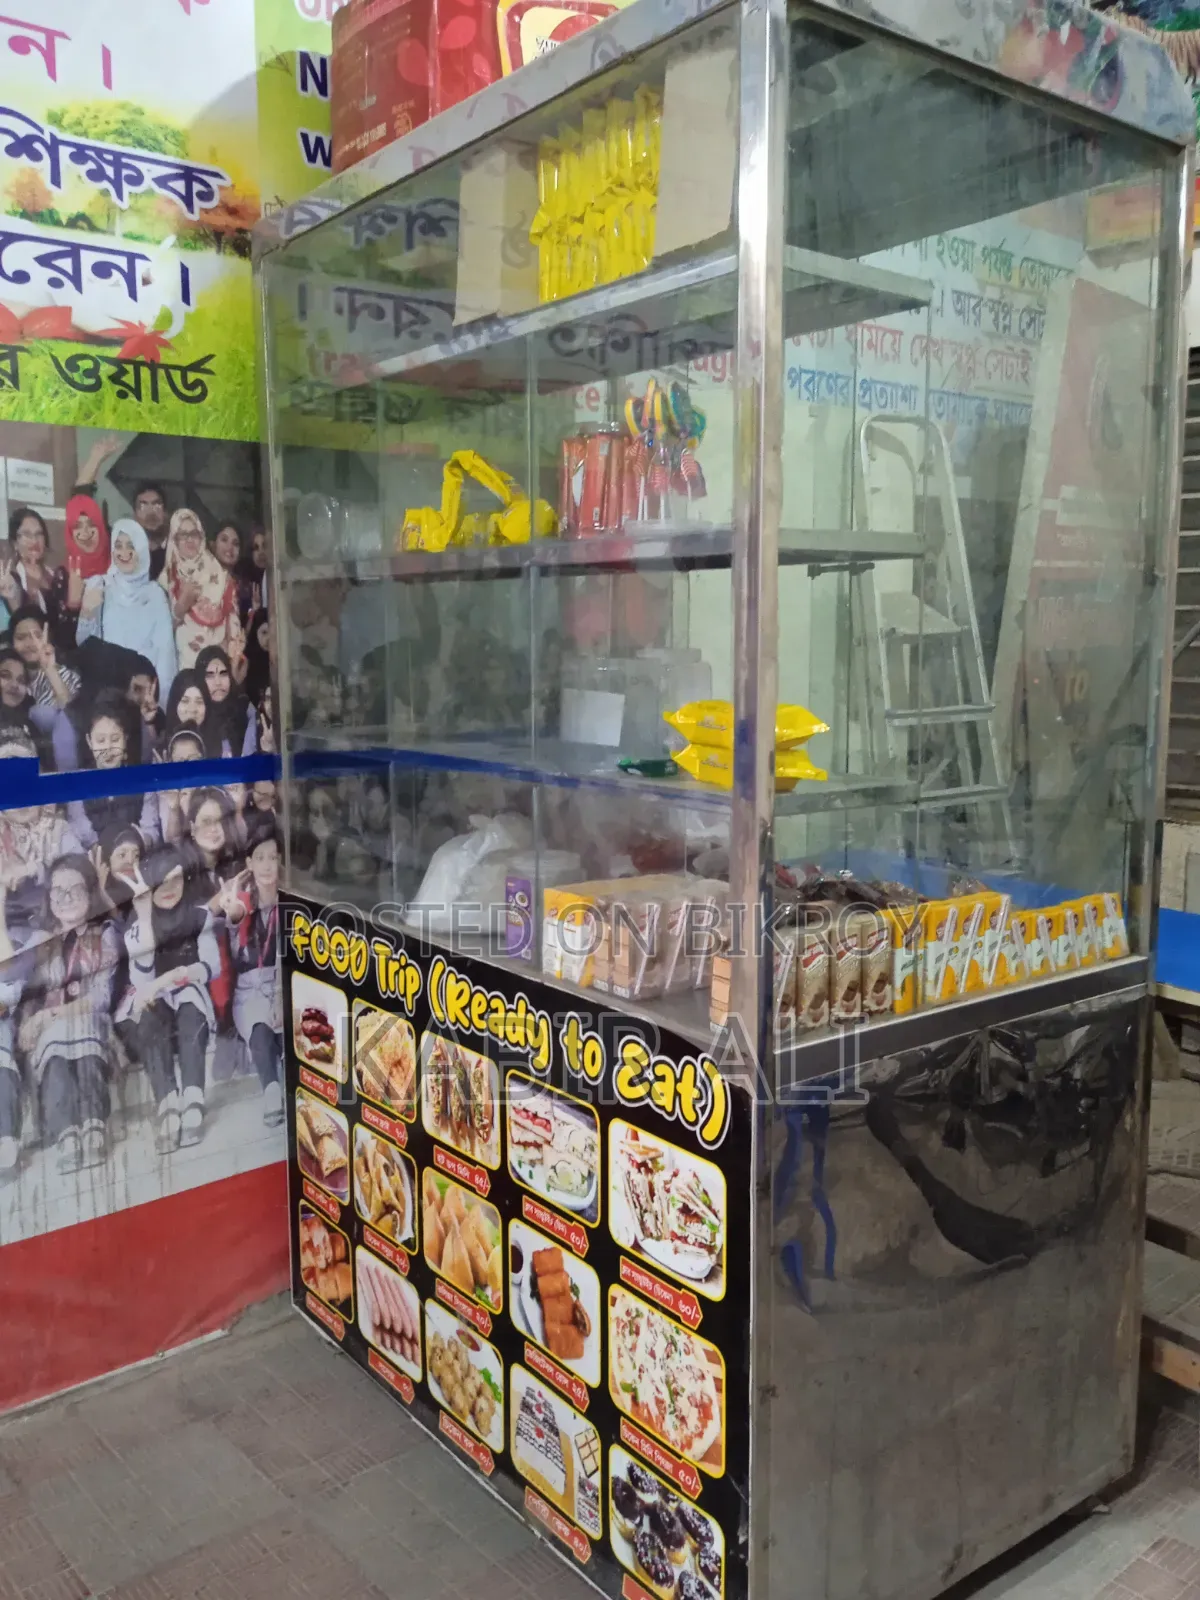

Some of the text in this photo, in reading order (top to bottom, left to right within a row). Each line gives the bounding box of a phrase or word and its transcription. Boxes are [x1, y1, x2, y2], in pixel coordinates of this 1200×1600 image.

[373, 941, 421, 1016] Trip
[427, 954, 552, 1071] (Ready
[560, 1022, 605, 1085] to
[611, 1037, 732, 1149] Eat)
[679, 1469, 700, 1491] ৫০/-
